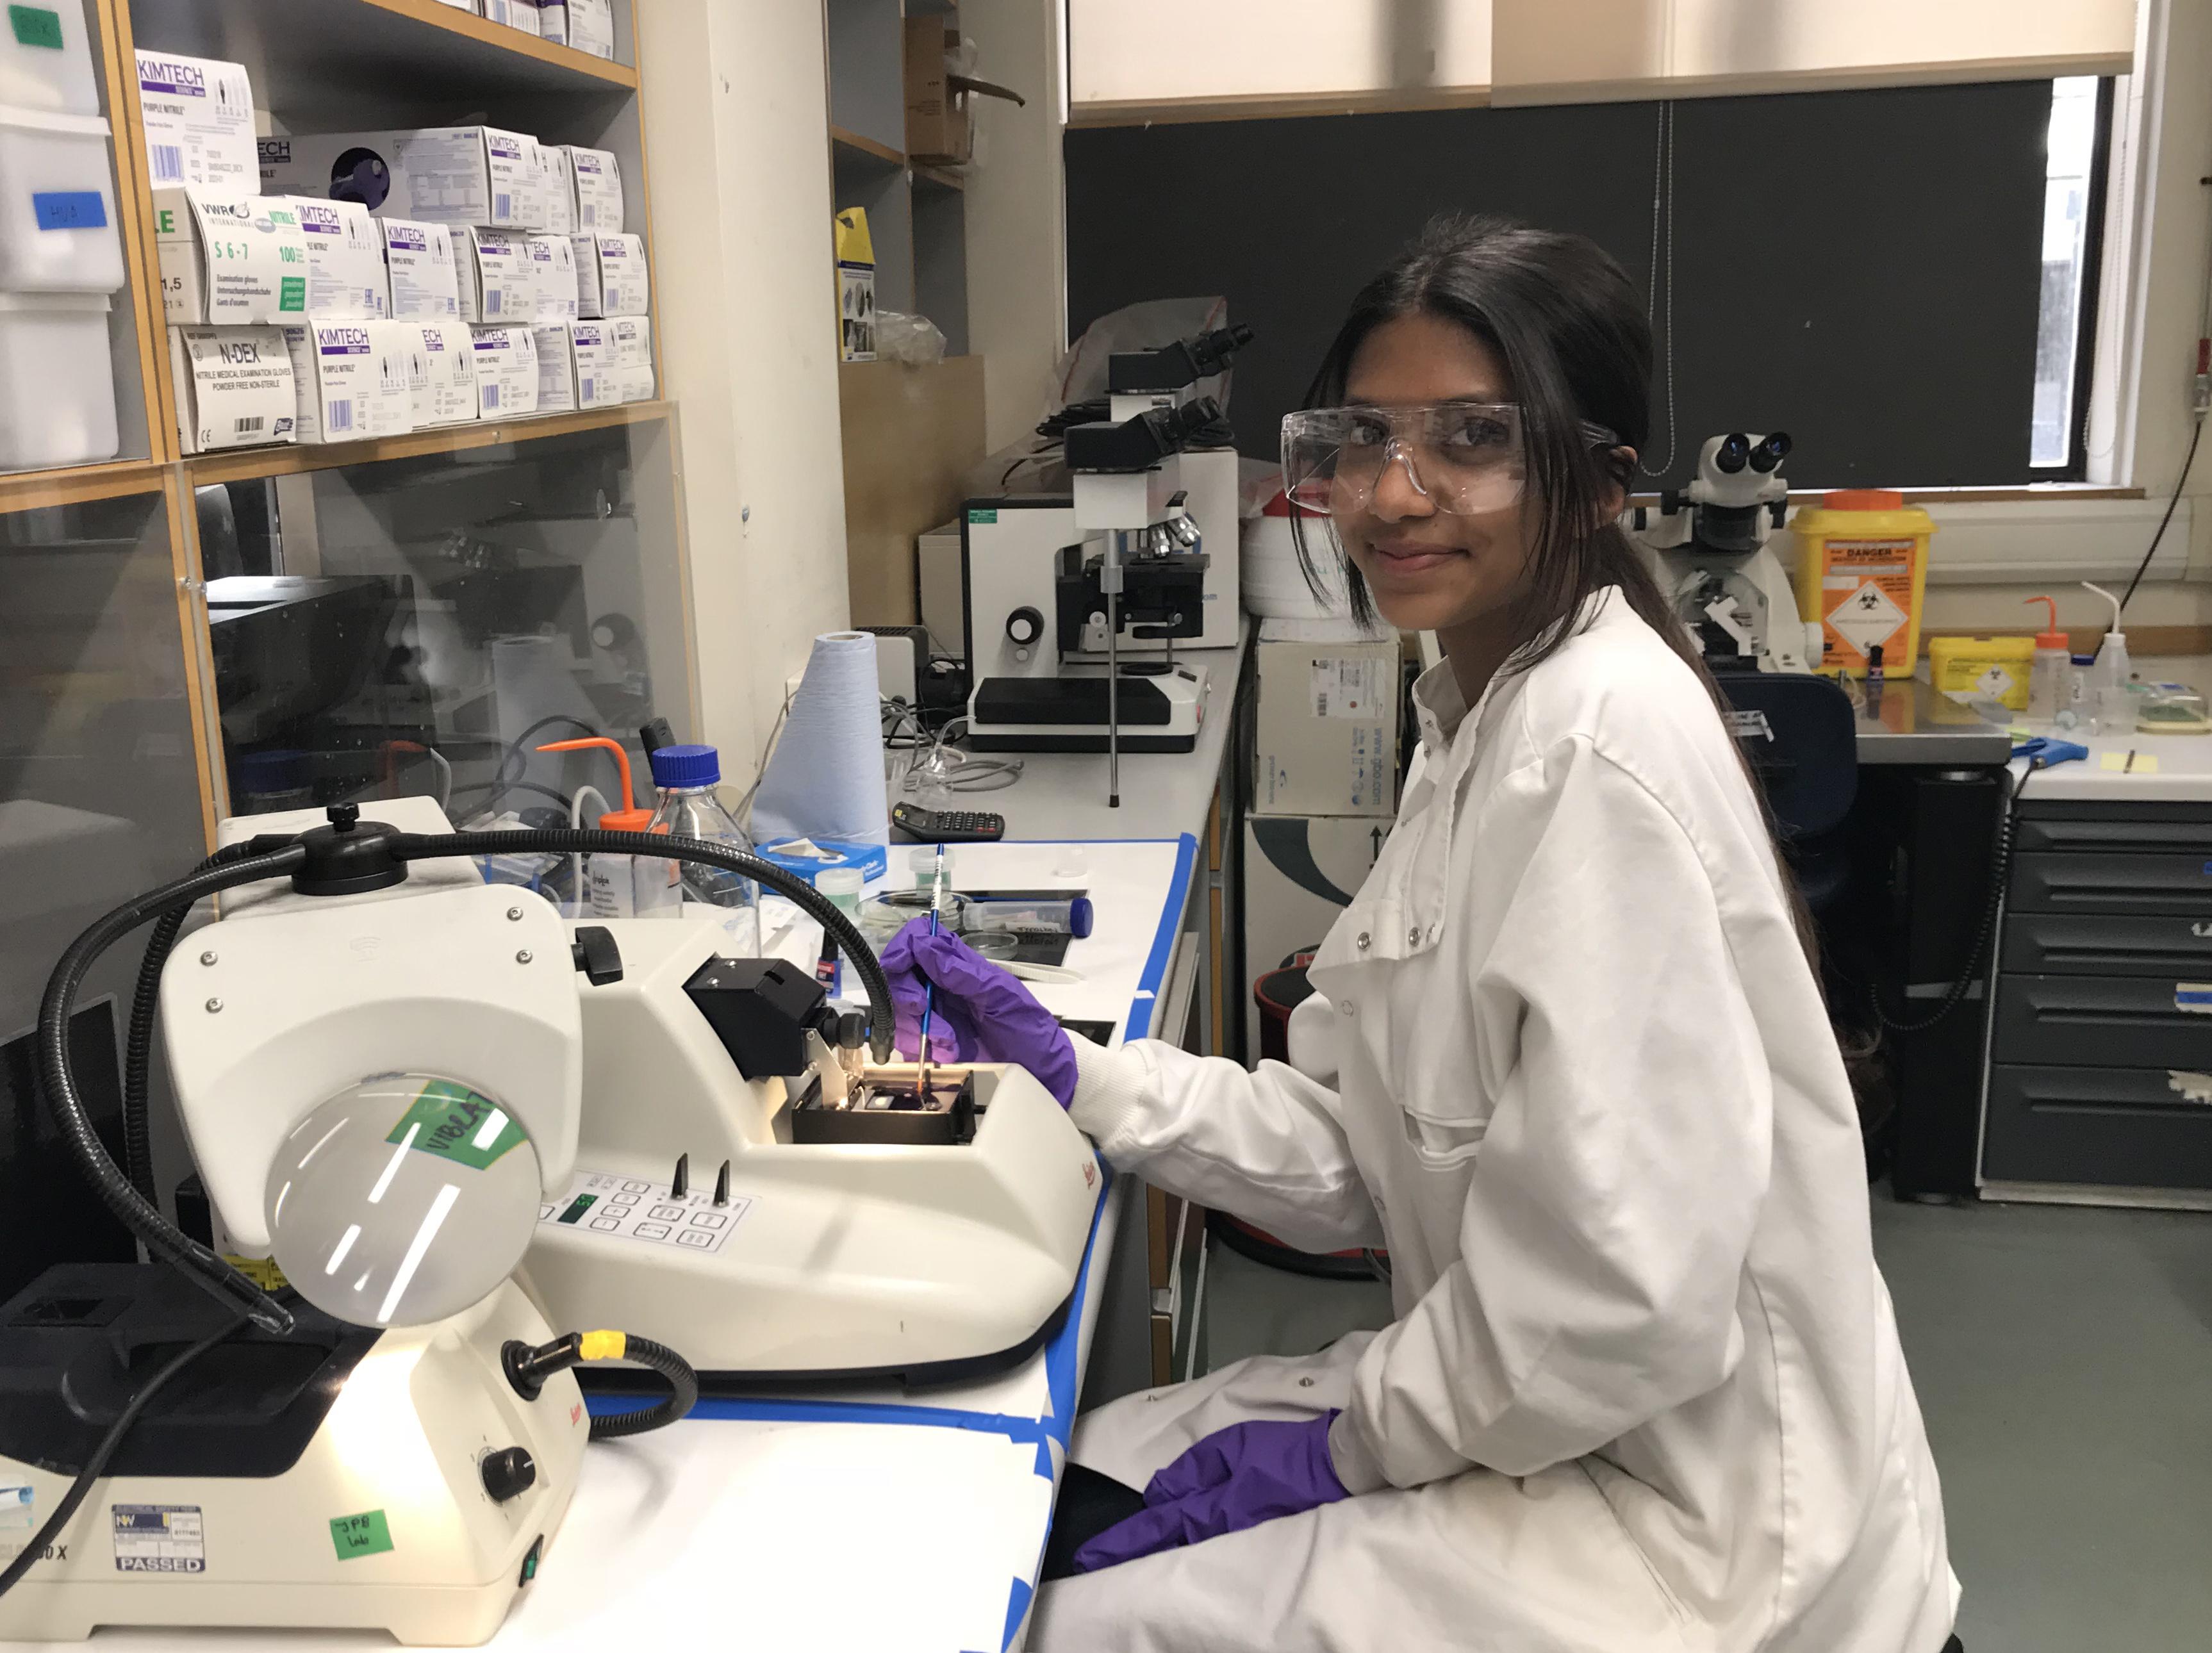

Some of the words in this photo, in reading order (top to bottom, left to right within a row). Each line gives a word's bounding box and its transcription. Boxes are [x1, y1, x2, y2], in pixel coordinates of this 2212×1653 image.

[137, 60, 204, 86] KIMTECH
[143, 102, 163, 113] PURPLE
[488, 135, 520, 151] KIMTECH
[574, 153, 600, 166] KIMTECH
[201, 203, 229, 215] VWR
[295, 204, 340, 224] IMTECH
[209, 217, 255, 229] INTERNATIONAL
[268, 210, 297, 226] NITRILE
[387, 225, 426, 243] KIMTECH
[476, 233, 510, 248] KIMTECH
[599, 238, 625, 250] KIMTECH
[279, 246, 296, 263] 100
[318, 328, 370, 345] KIMTECH
[471, 328, 508, 342] KIMTECH
[572, 325, 600, 340] KIMTECH
[219, 343, 261, 364] N-DEX
[196, 370, 216, 379] NITRILE
[217, 370, 239, 379] MEDICAL
[240, 368, 272, 378] EXAMINATION
[273, 368, 292, 376] GLOVES
[213, 382, 235, 391] POWDER
[236, 381, 249, 390] FREE
[249, 380, 280, 390] NON-STERILE
[1371, 727, 1383, 805] www.gbo.com
[121, 1558, 201, 1572] PASSED
